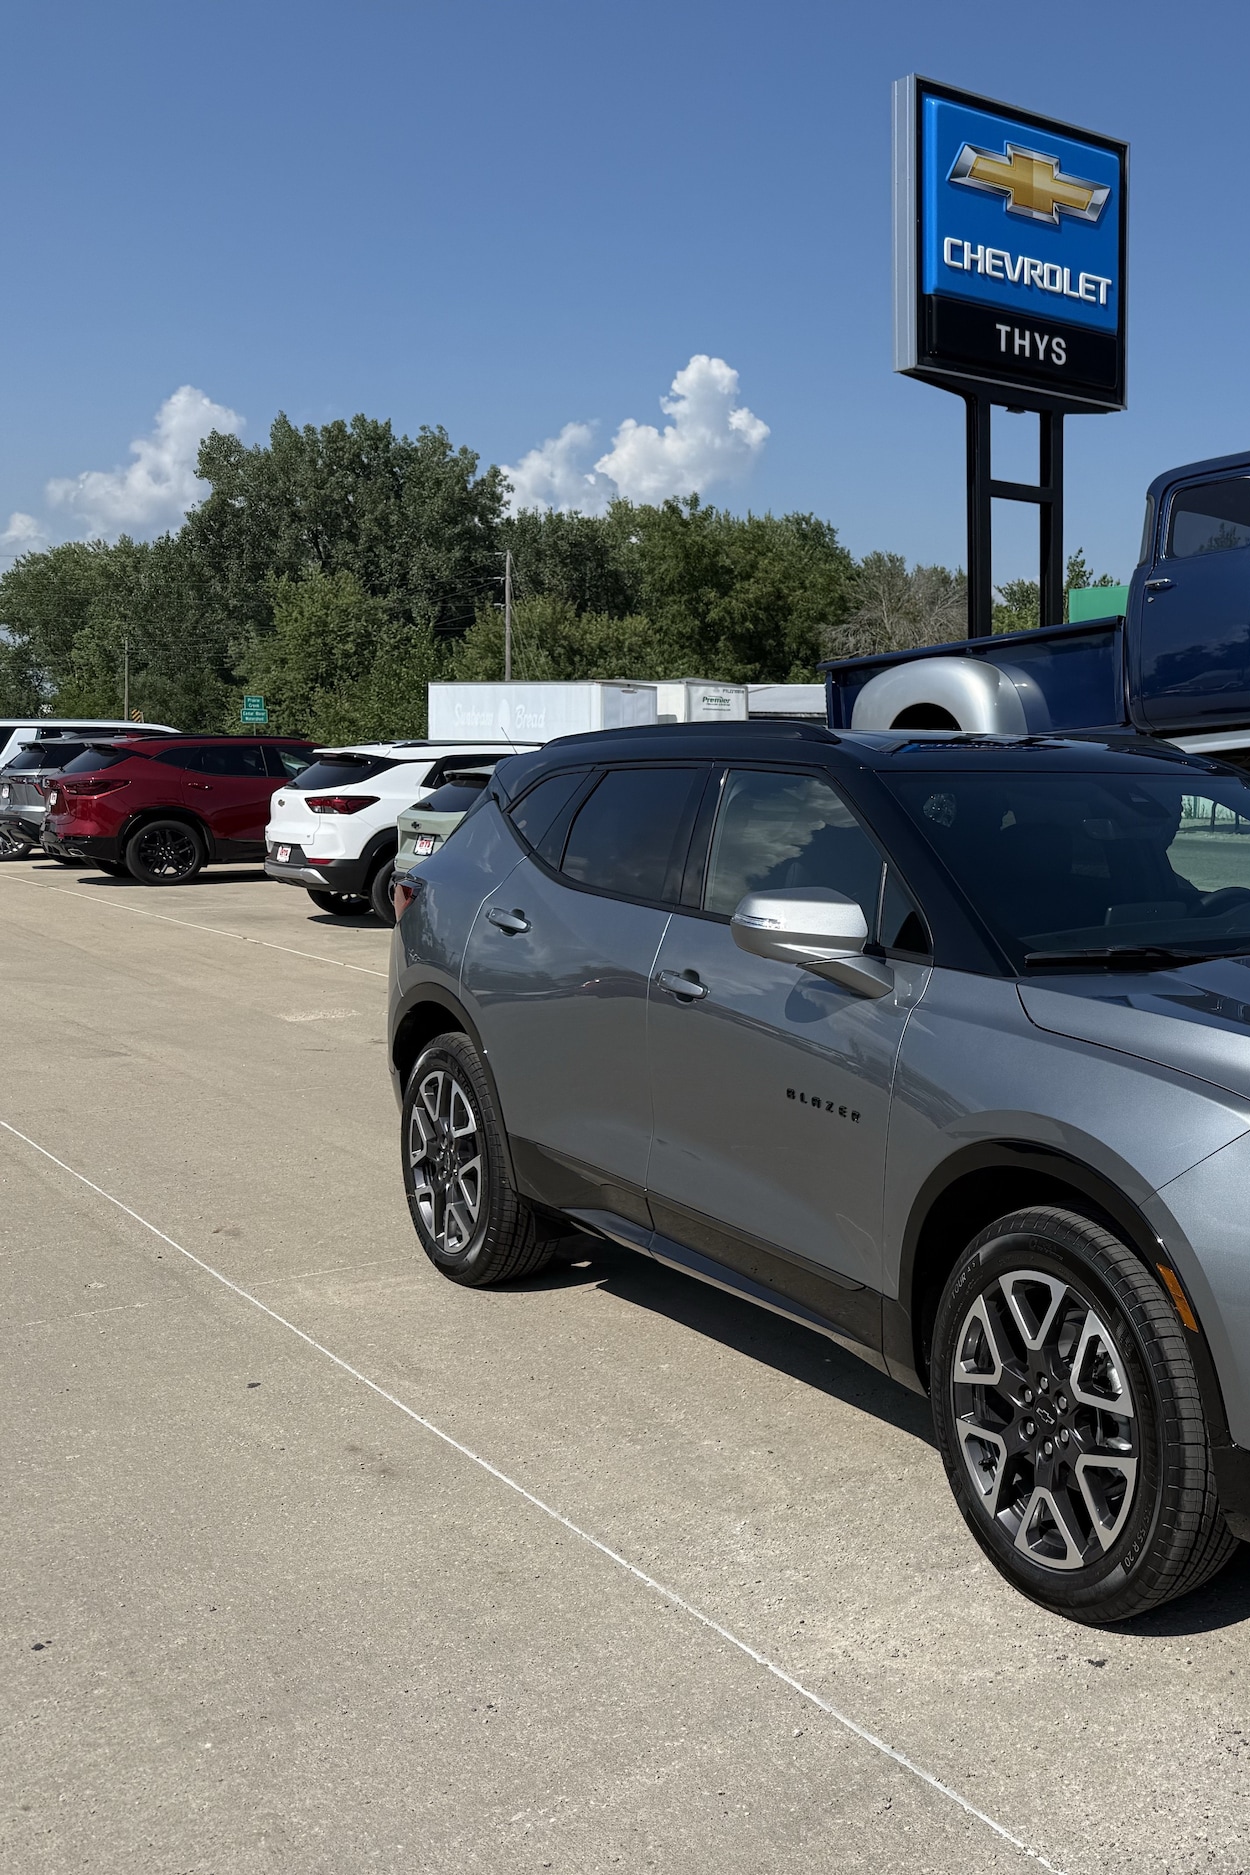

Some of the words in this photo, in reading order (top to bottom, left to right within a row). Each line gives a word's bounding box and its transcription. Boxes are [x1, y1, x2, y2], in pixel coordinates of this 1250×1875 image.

[943, 237, 1112, 305] CHEVROLET
[996, 323, 1067, 366] THYS
[515, 703, 546, 729] Bread
[786, 1087, 861, 1124] BLAZER
